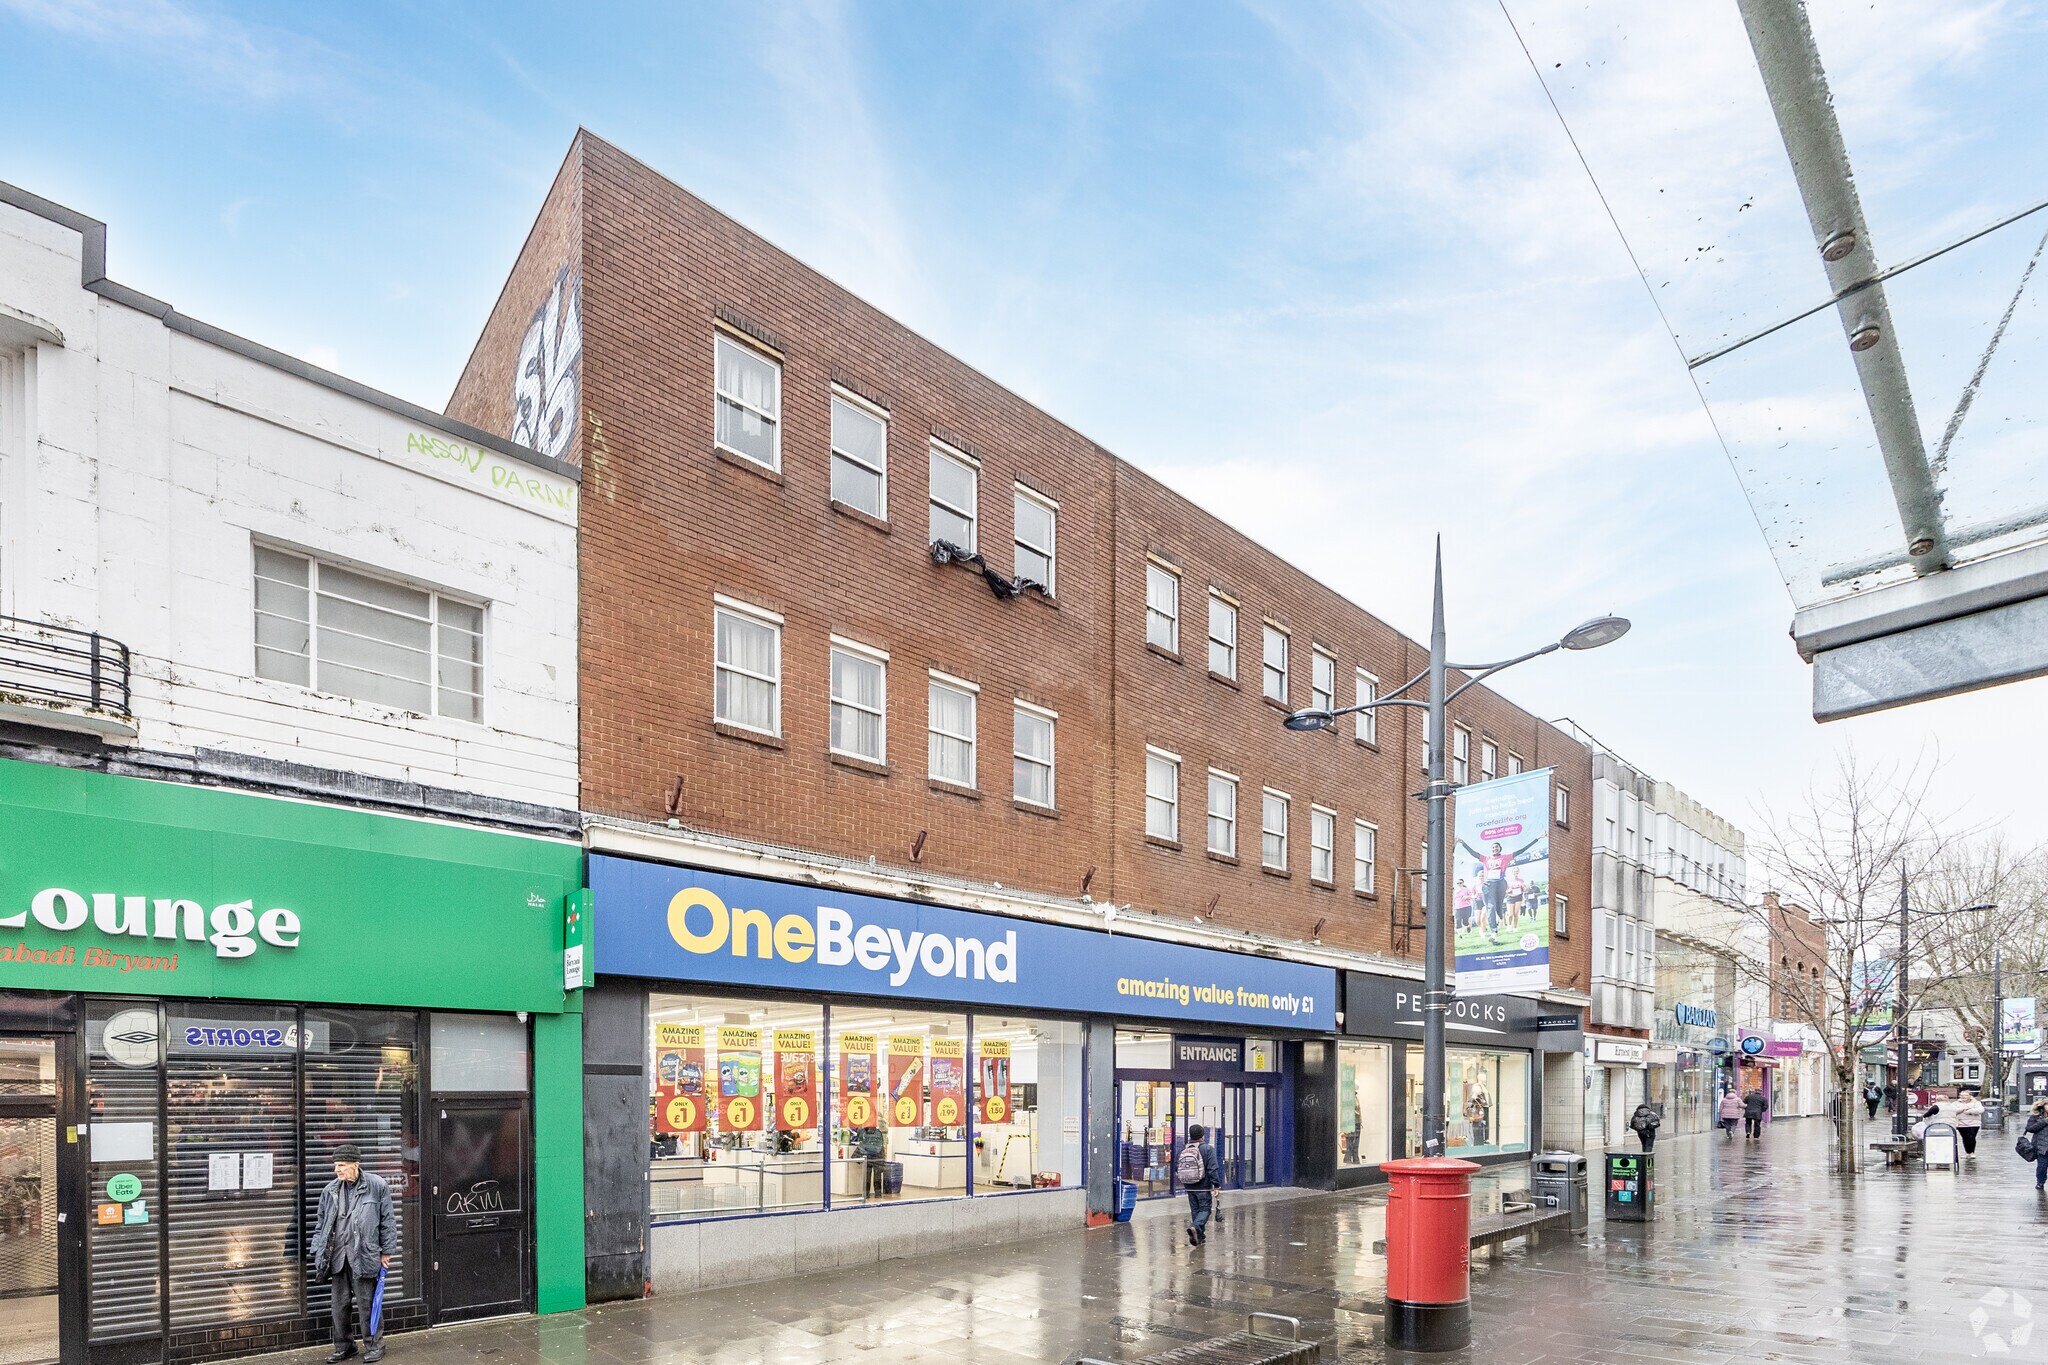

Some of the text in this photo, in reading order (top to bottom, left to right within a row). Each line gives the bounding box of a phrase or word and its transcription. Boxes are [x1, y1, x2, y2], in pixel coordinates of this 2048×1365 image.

[407, 432, 485, 473] ARSON
[666, 887, 1017, 987] OneBeyond
[83, 947, 179, 973] Biryani
[1117, 977, 1314, 1016] amazing value from only £1
[1396, 992, 1506, 1022] PECOCKS
[1685, 1004, 1717, 1028] BARCLAYS
[662, 1035, 700, 1044] VALUE!
[723, 1038, 758, 1047] VALUE!
[845, 1042, 874, 1050] VALUE!
[1180, 1046, 1237, 1062] ENTRANCE
[674, 1108, 687, 1123] £1
[734, 1108, 746, 1122] £1
[790, 1107, 801, 1122] £1
[853, 1106, 863, 1119] £1
